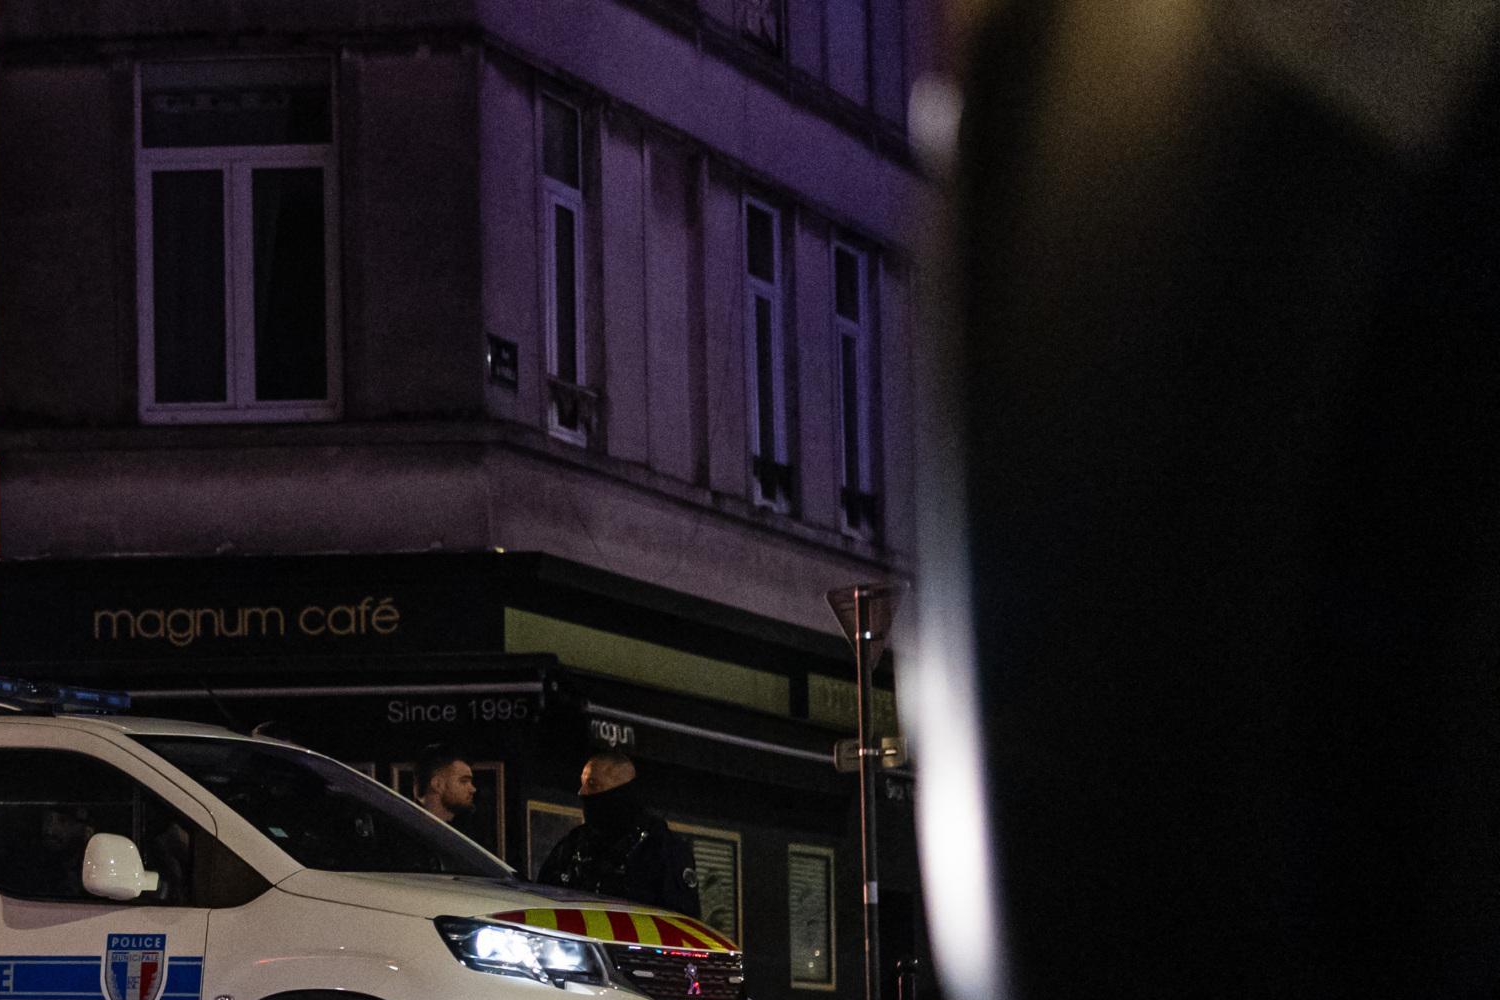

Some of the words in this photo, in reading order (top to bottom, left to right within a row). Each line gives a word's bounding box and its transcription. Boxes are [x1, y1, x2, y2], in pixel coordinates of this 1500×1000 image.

[92, 606, 285, 647] magnum
[297, 596, 401, 637] café
[387, 700, 457, 723] Since
[468, 698, 529, 721] 1995
[111, 937, 161, 948] POLICE
